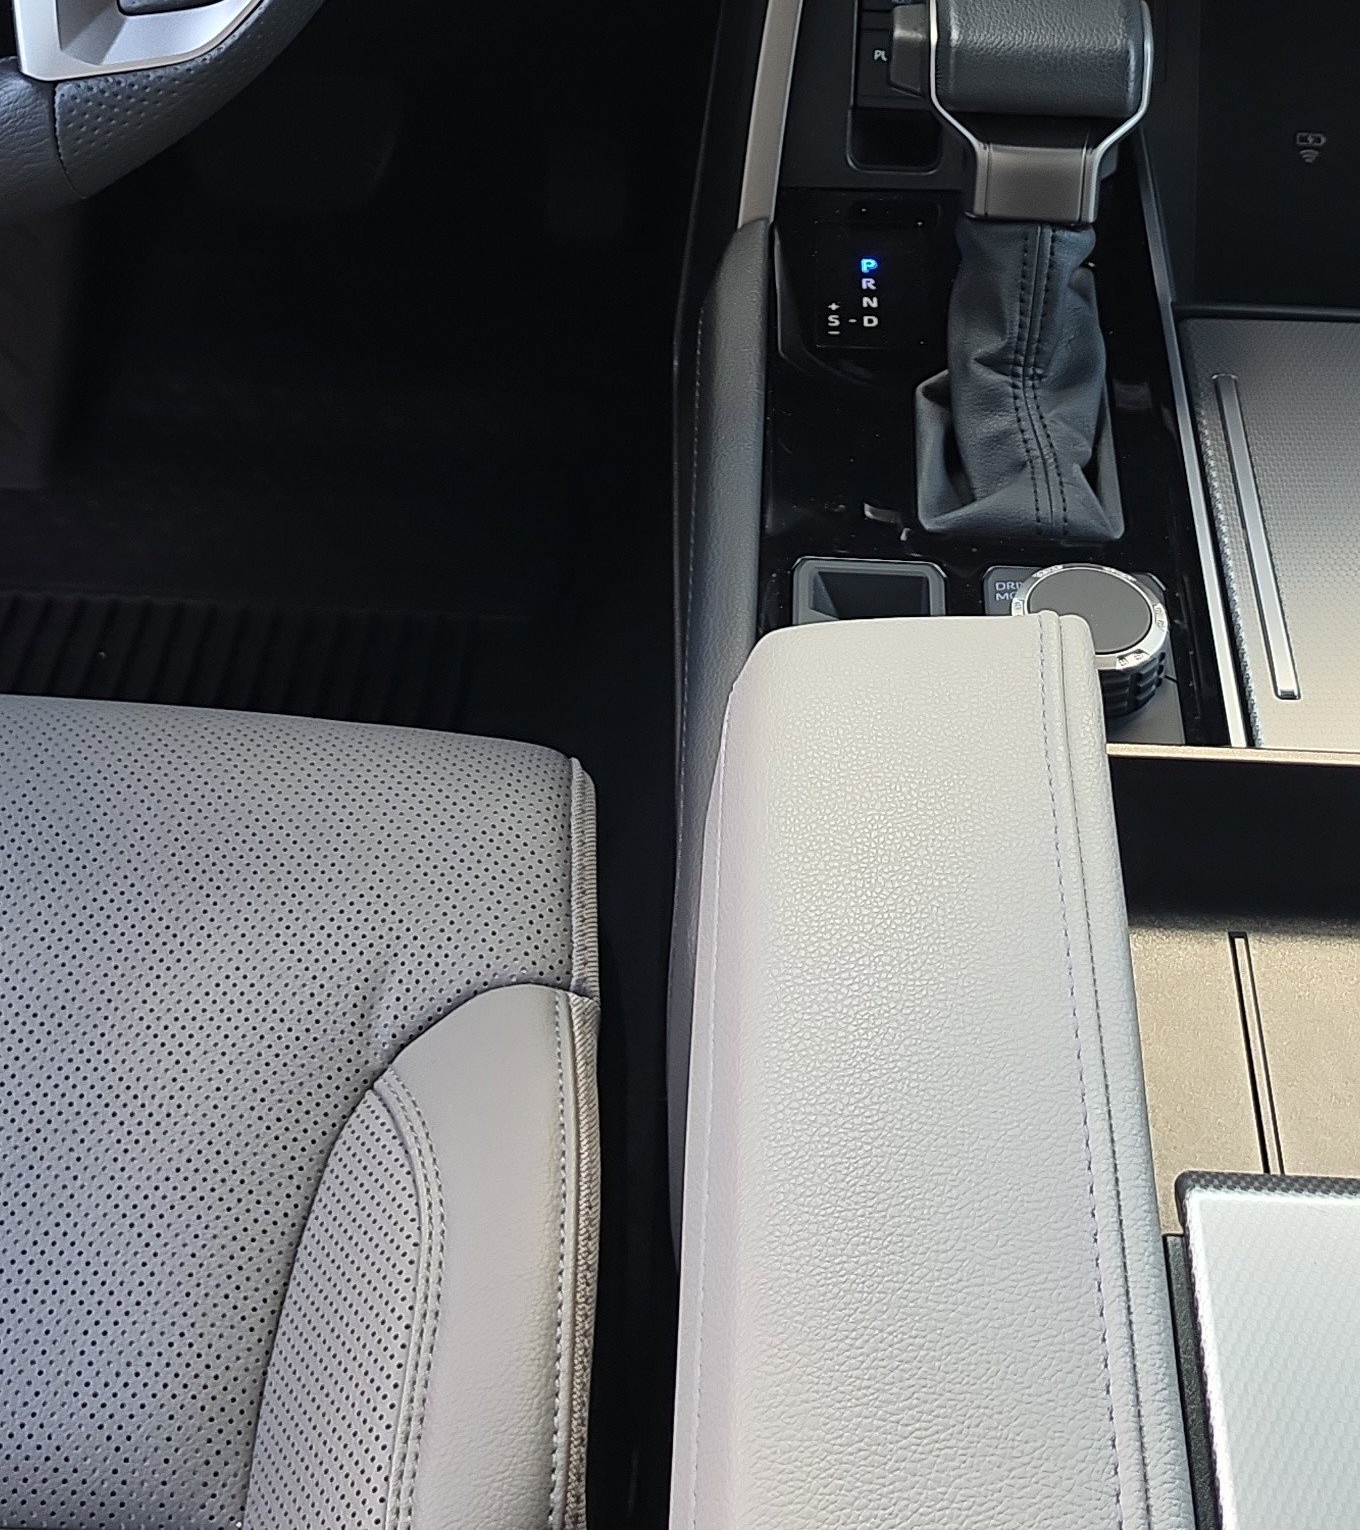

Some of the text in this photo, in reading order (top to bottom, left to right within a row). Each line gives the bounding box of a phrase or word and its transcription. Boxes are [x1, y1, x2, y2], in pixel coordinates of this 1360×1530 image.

[861, 257, 878, 272] P
[862, 278, 877, 290] R
[862, 296, 878, 308] N
[863, 315, 879, 327] D
